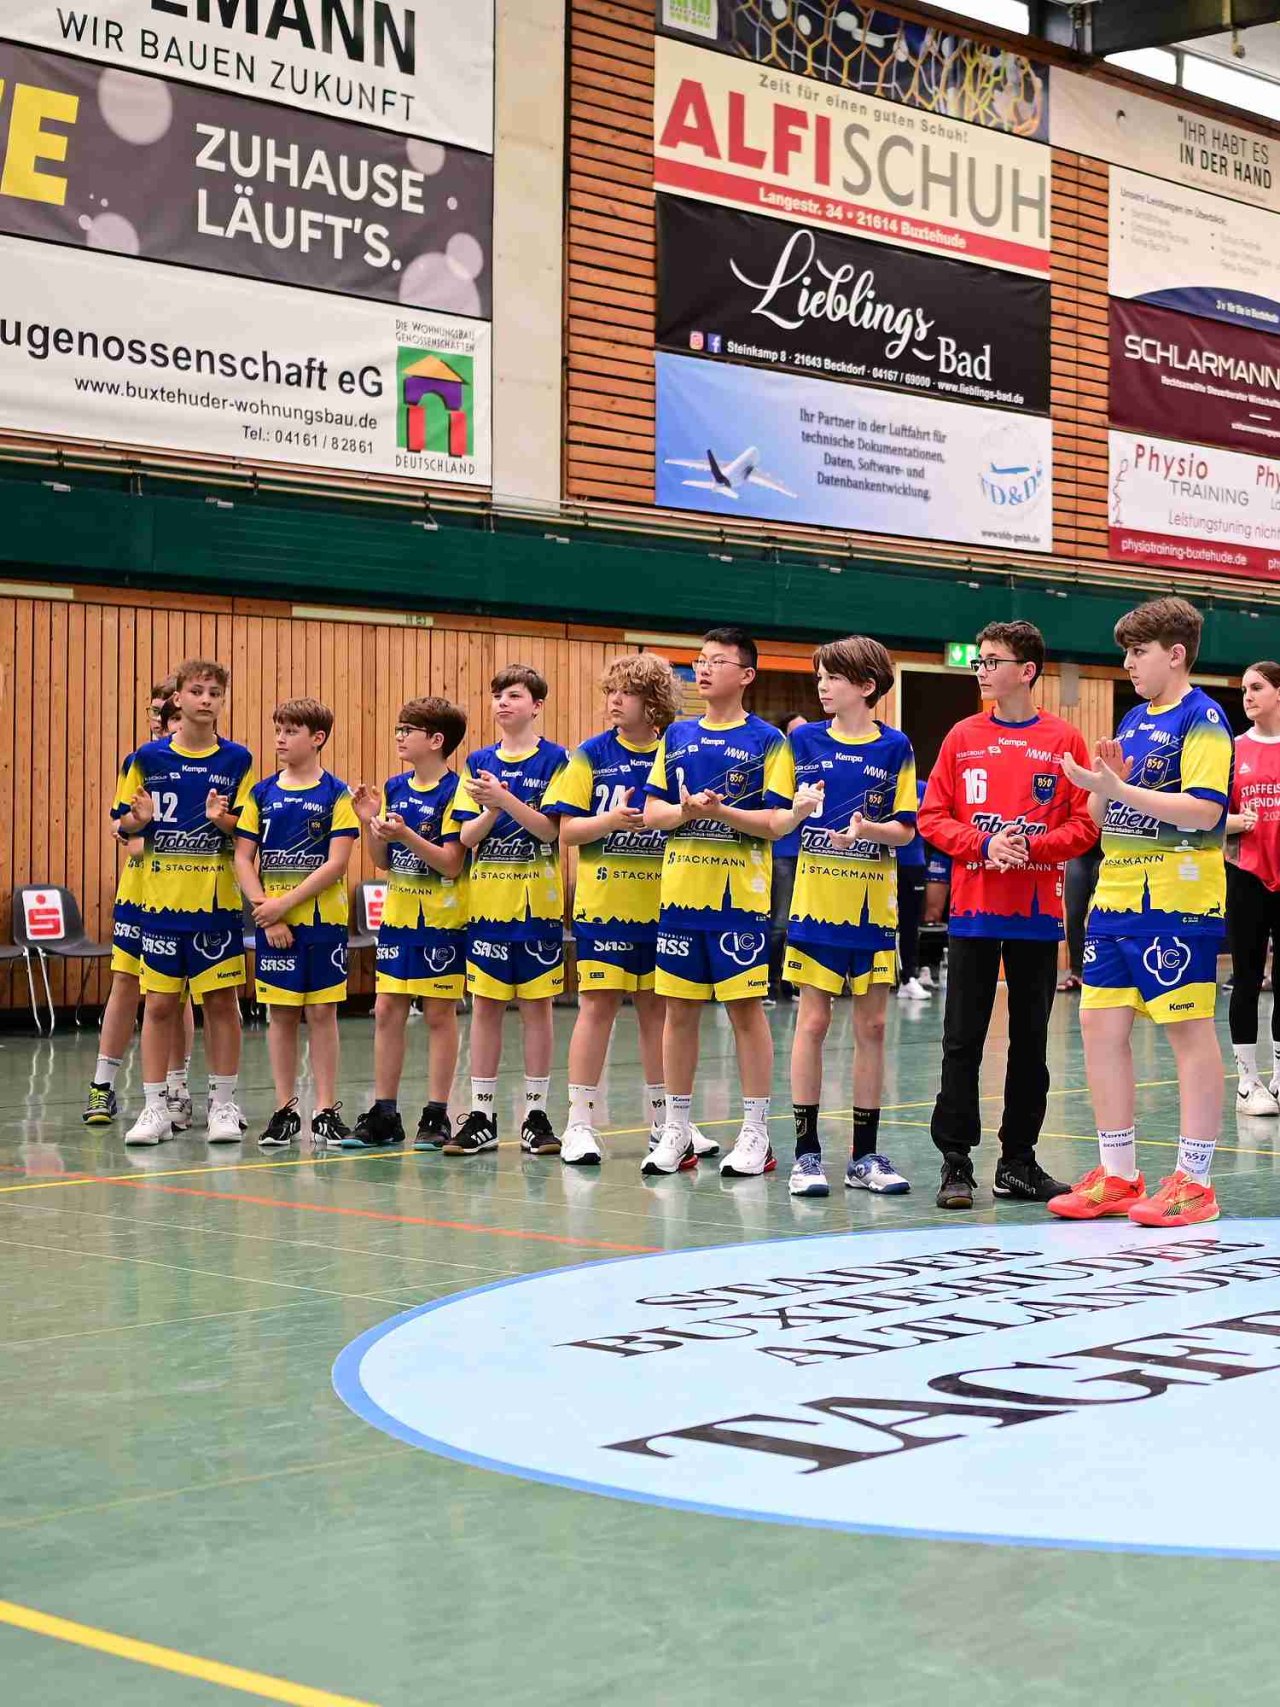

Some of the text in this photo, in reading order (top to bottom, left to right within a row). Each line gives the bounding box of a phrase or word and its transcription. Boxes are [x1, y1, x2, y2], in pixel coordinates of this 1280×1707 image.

[56, 8, 416, 121] WIR BAUEN ZUKUNFT
[758, 74, 969, 145] Zeit für einen guten Schuh!
[1211, 127, 1269, 166] HABT ES
[195, 123, 426, 214] ZUHAUSE
[1180, 142, 1195, 167] IN
[1200, 148, 1228, 177] DER
[1233, 160, 1273, 190] HAND
[197, 183, 403, 272] LÄUFT'S.
[759, 186, 967, 250] Langestr. 34 21614 Buxtehude
[729, 228, 935, 361] Lieblings
[727, 340, 779, 363] Steinkamp
[780, 349, 787, 363] 8
[794, 352, 822, 370] 21643
[824, 357, 866, 377] Beckdorf
[938, 379, 1025, 405] www.lieblings-bad.de
[936, 336, 992, 382] Bad
[338, 363, 384, 399] eG
[75, 376, 378, 431] www.buxtehuder-wohnungsbau.de
[241, 424, 375, 456] Tel.: 04161 82861
[800, 409, 947, 445] Ihr Partner in der Luftfahrt für
[801, 430, 855, 452] technische
[395, 455, 475, 475] DEUTSCHLAND
[858, 457, 904, 478] Software-
[906, 464, 925, 480] und
[1134, 443, 1209, 481] Physio
[1168, 479, 1249, 507] TRAINING
[1255, 522, 1280, 540] nicht
[1121, 538, 1247, 566] physiotraining-buxtehude.de
[701, 736, 726, 747] Kempa
[724, 746, 750, 762] MWM
[835, 752, 863, 763] Kempa
[998, 737, 1028, 748] Kempa
[1025, 748, 1052, 763] MWM
[863, 764, 888, 780] MWM
[962, 768, 988, 805] 16
[262, 818, 272, 844] 7
[676, 853, 746, 869] STACKMANN
[809, 865, 885, 881] STACKMANN
[1168, 1000, 1195, 1012] Kempa
[634, 1246, 1044, 1312] STADER
[552, 1238, 1264, 1358] BUXTEHUDER
